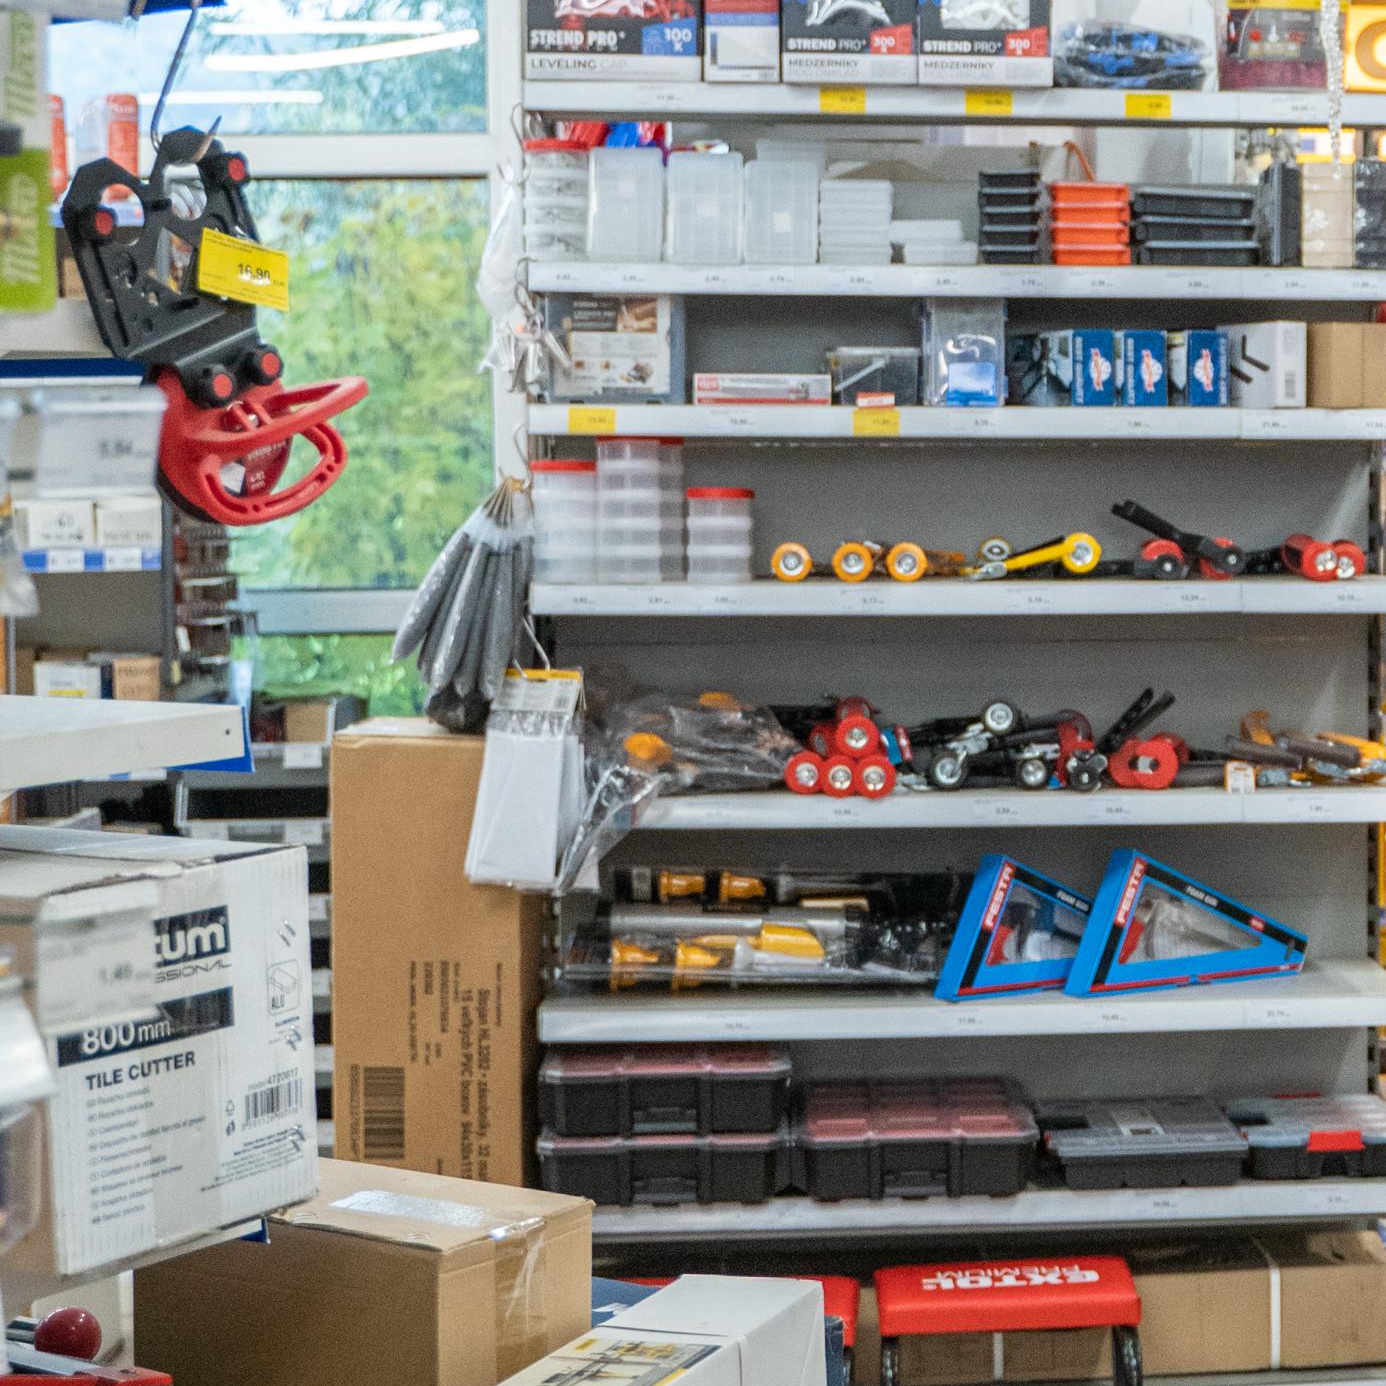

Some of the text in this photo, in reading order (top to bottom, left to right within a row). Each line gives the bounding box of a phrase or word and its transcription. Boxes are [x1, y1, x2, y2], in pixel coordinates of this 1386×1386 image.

[530, 29, 617, 47] STREND PRO
[664, 27, 692, 41] 100
[787, 38, 862, 51] STREND PRO
[923, 40, 997, 53] STREND PRO
[531, 58, 597, 70] LEVELING
[985, 867, 1014, 928] FESTA
[1117, 863, 1145, 926] FESTA
[156, 921, 227, 961] um
[82, 1020, 171, 1055] 800 mm
[86, 1051, 196, 1091] TILE CUTTER
[922, 1269, 1100, 1291] EXTOL
